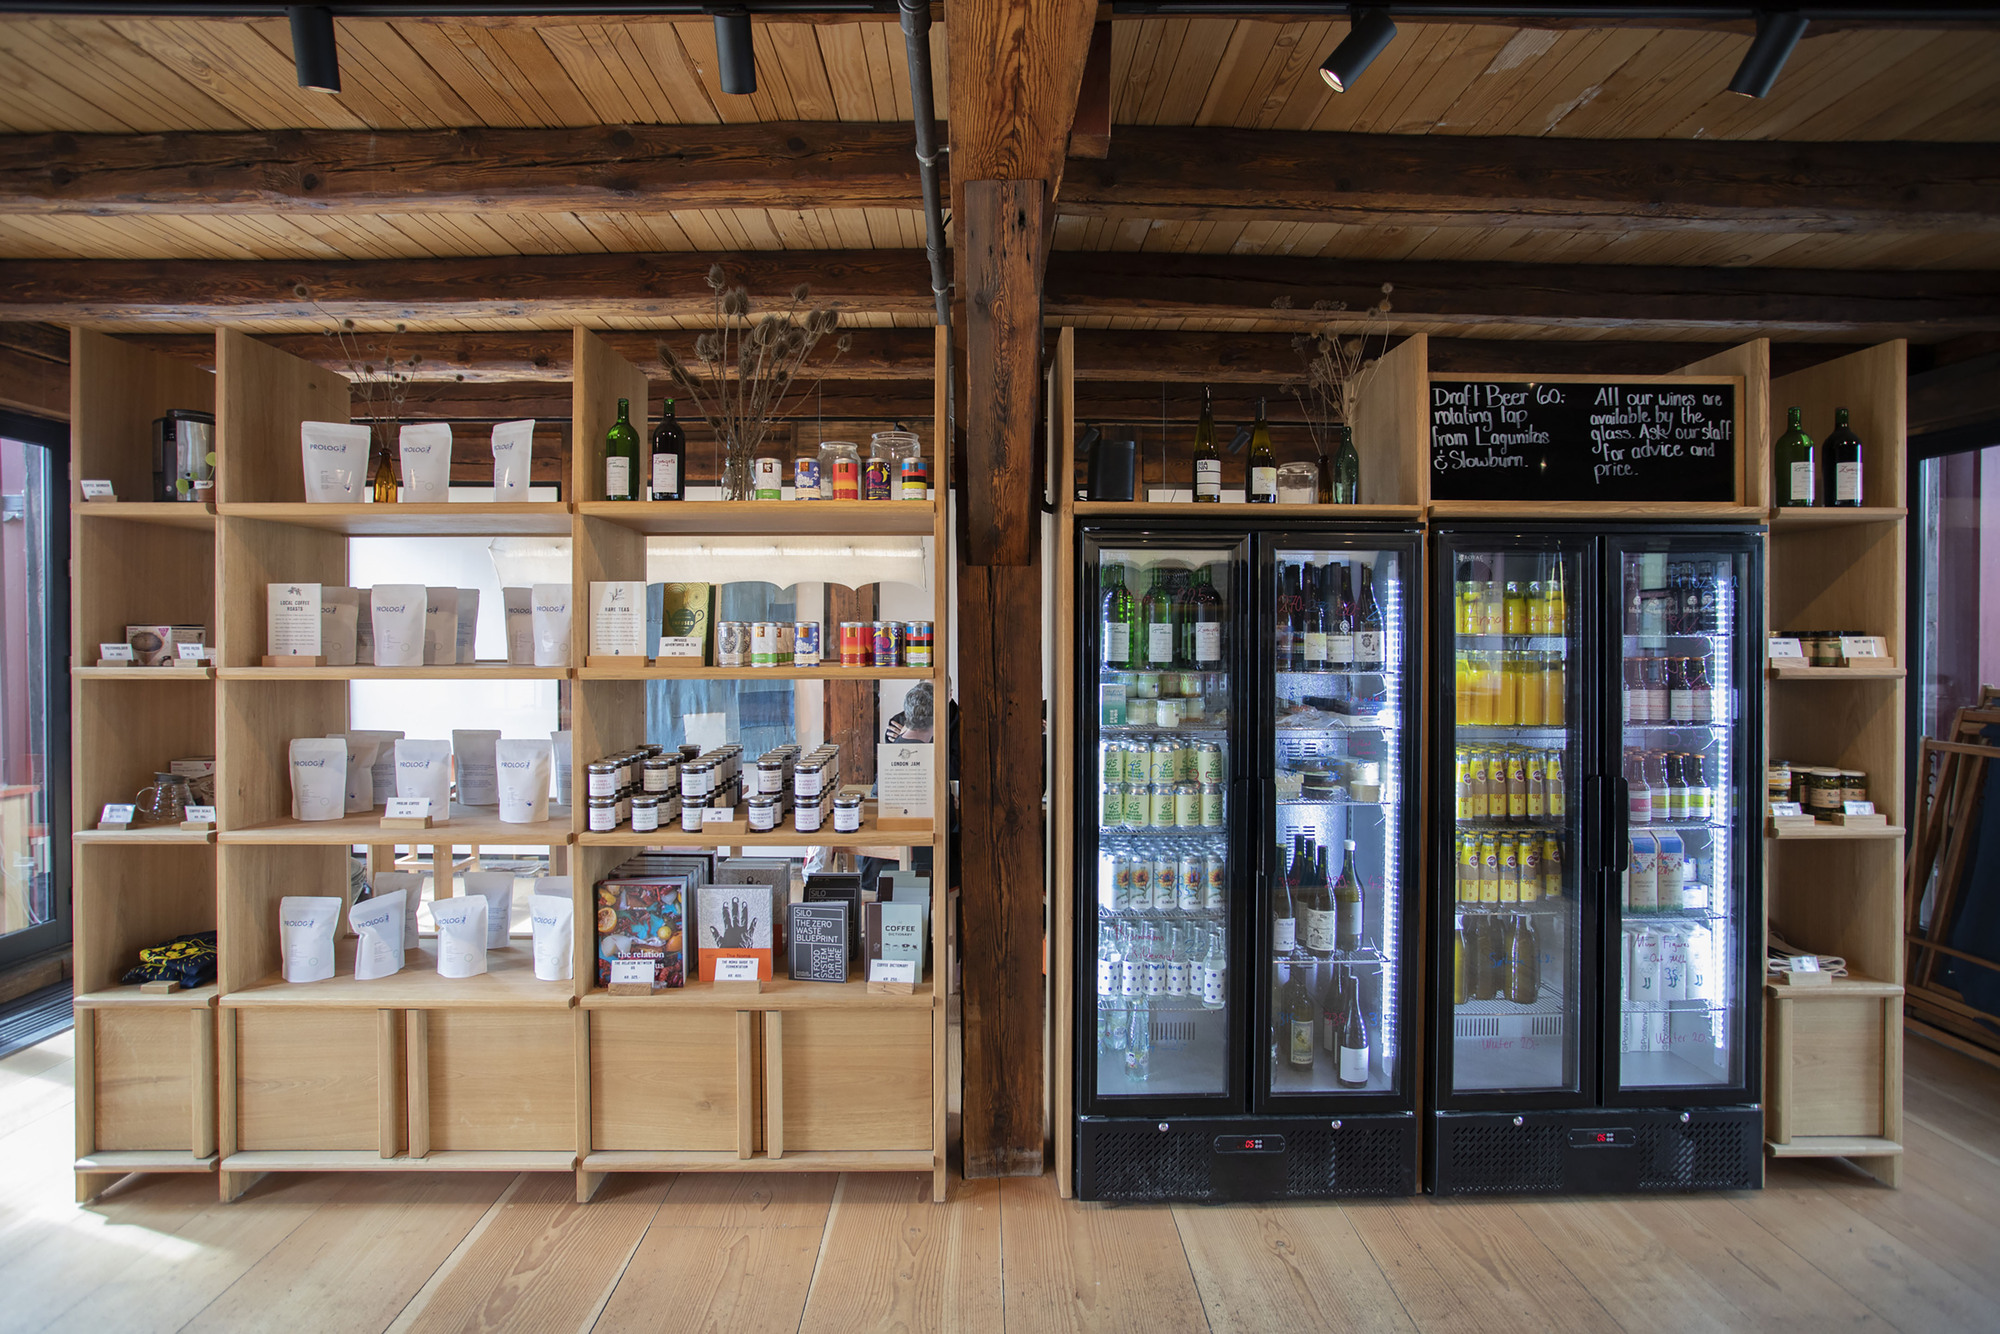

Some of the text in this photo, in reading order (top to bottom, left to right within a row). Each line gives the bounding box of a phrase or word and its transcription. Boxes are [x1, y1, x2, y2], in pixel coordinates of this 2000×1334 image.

[1432, 384, 1480, 406] Draft
[1485, 384, 1529, 408] Beer
[1594, 387, 1723, 406] All our wines are
[1434, 405, 1528, 432] rotating tap
[1590, 405, 1705, 435] available by the
[1432, 424, 1550, 455] from Lagunitas
[1591, 420, 1732, 454] glass. Ask our staff
[1603, 439, 1715, 461] for advice and
[1434, 448, 1529, 474] & Slowburn.
[1594, 462, 1639, 484] price.
[1106, 759, 1118, 767] 45
[1108, 802, 1119, 810] 45
[1128, 802, 1140, 810] 45
[358, 916, 385, 928] PROLOG
[795, 909, 812, 917] SILO
[796, 919, 811, 927] THE
[796, 927, 821, 935] WASTE
[796, 934, 838, 943] BLUEPRINT
[618, 949, 664, 958] the relation
[834, 948, 842, 979] FUTURE
